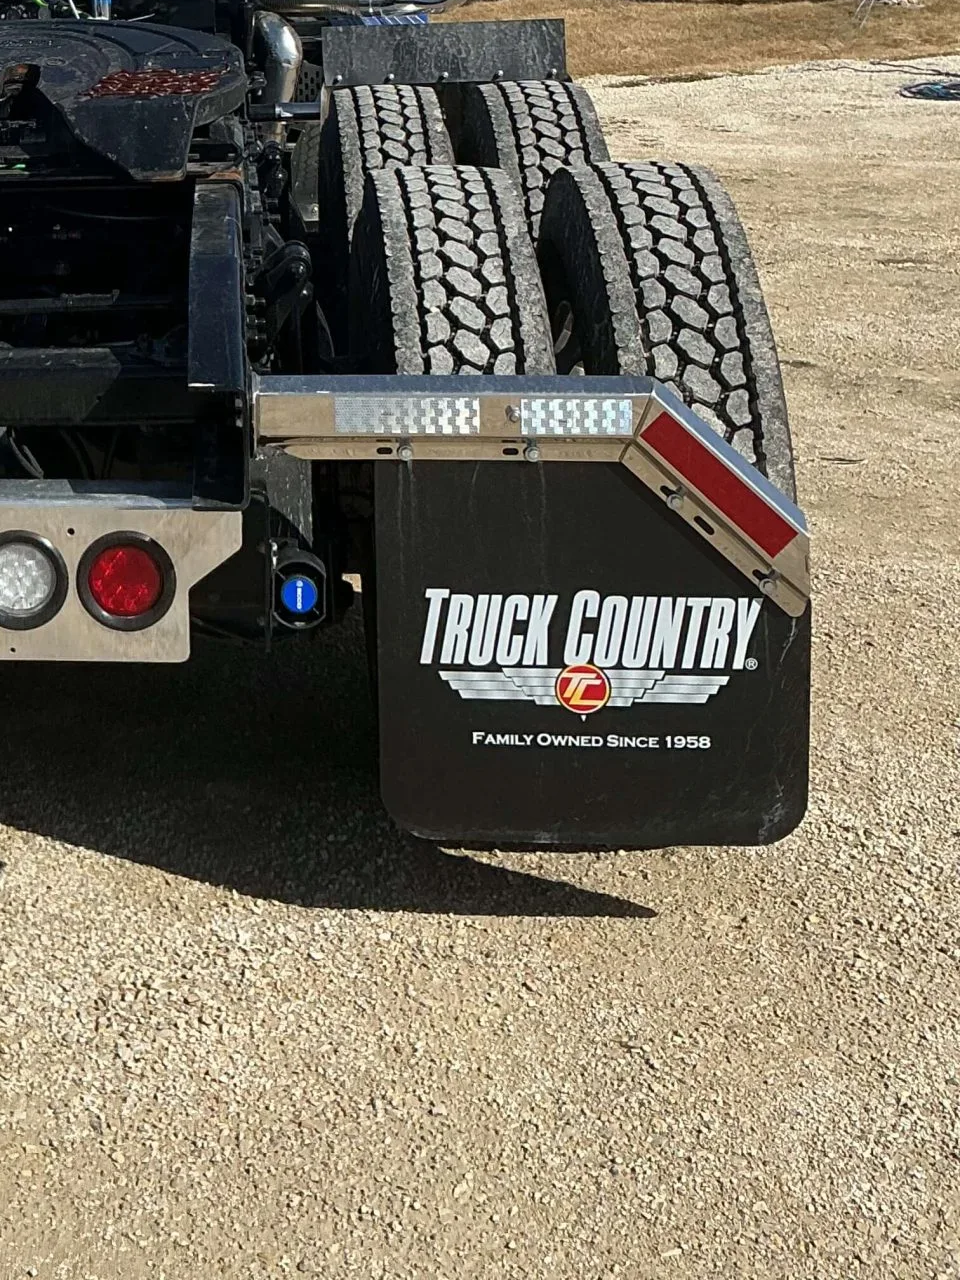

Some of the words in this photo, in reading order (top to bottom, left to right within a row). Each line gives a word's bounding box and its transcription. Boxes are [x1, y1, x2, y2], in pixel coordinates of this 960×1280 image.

[420, 588, 558, 666] TRUCK
[472, 731, 532, 747] FAMILY
[536, 732, 603, 748] OWNED
[606, 733, 659, 748] SINCE
[664, 735, 711, 749] 1958
